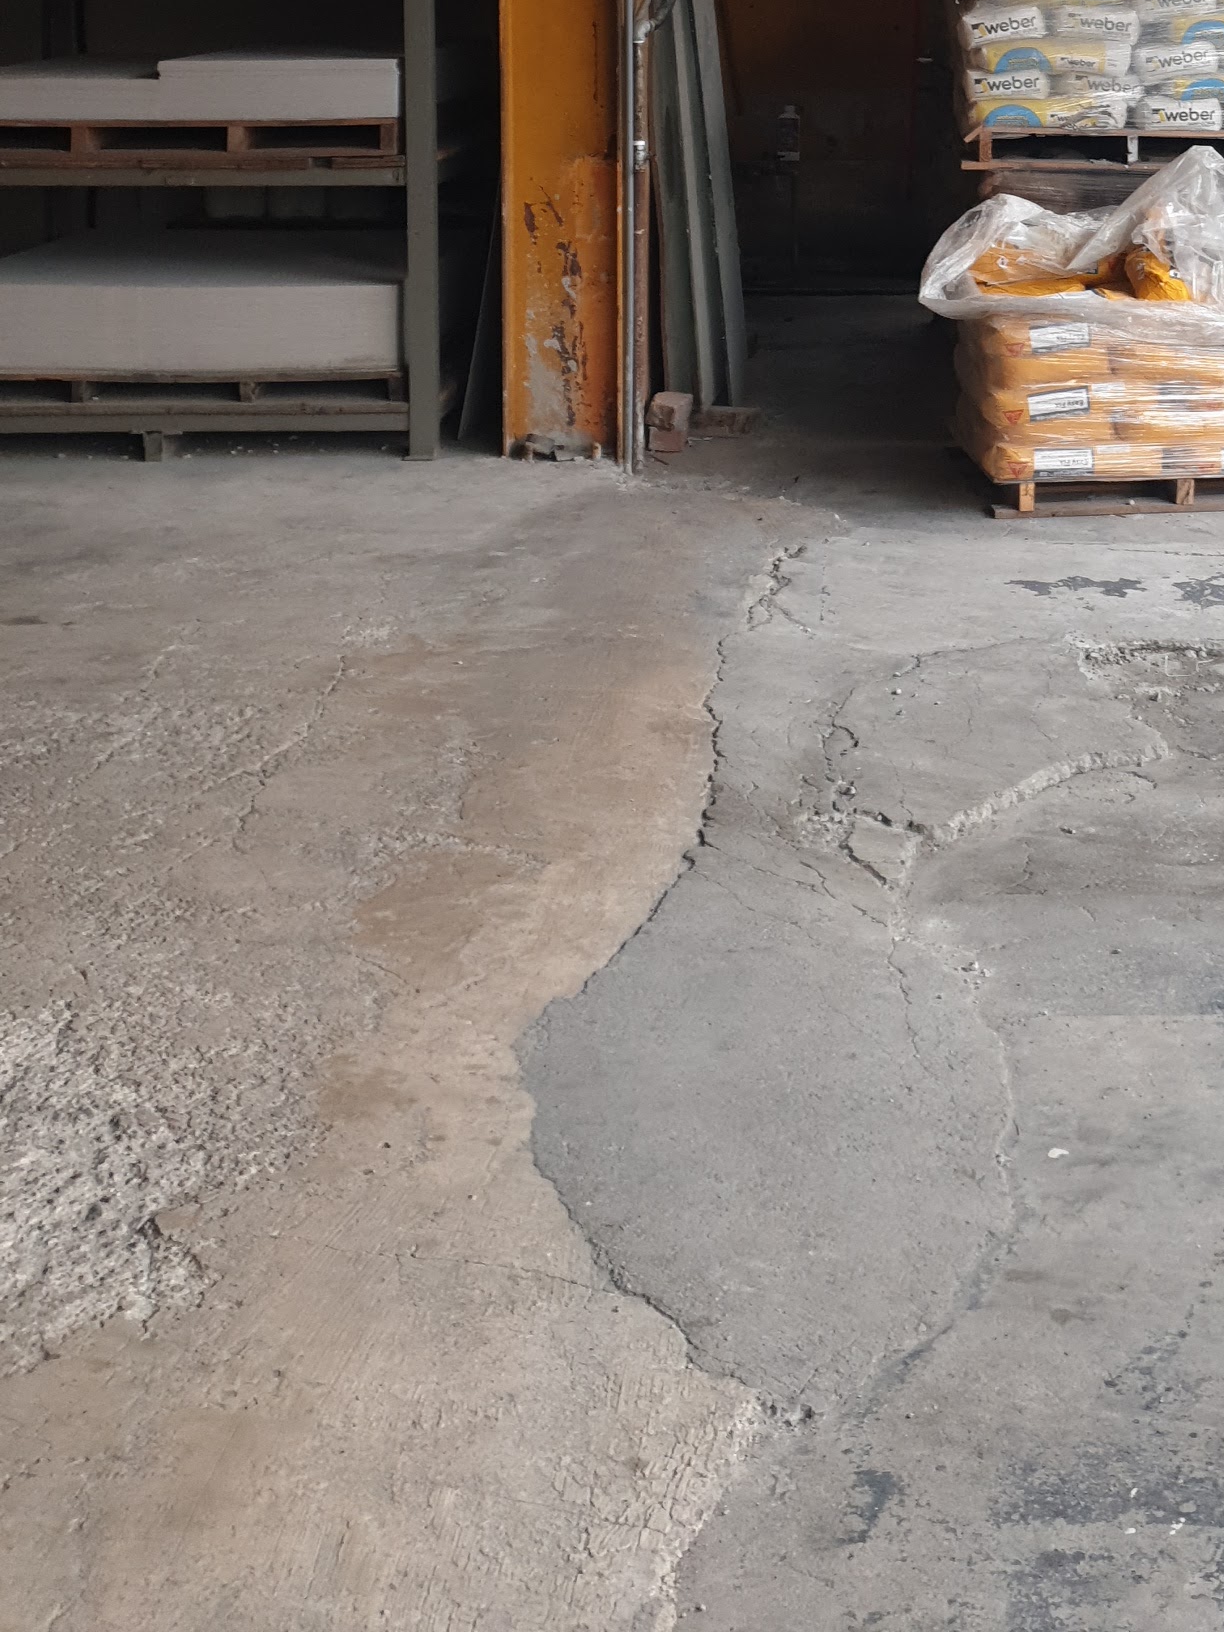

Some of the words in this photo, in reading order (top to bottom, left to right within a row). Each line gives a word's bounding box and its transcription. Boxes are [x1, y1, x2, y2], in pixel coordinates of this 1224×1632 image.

[986, 16, 1037, 35] weber
[1080, 17, 1132, 32] weber
[1067, 58, 1096, 68] weber
[1159, 50, 1208, 68] weber
[987, 76, 1040, 91] weber
[1165, 108, 1216, 122] weber
